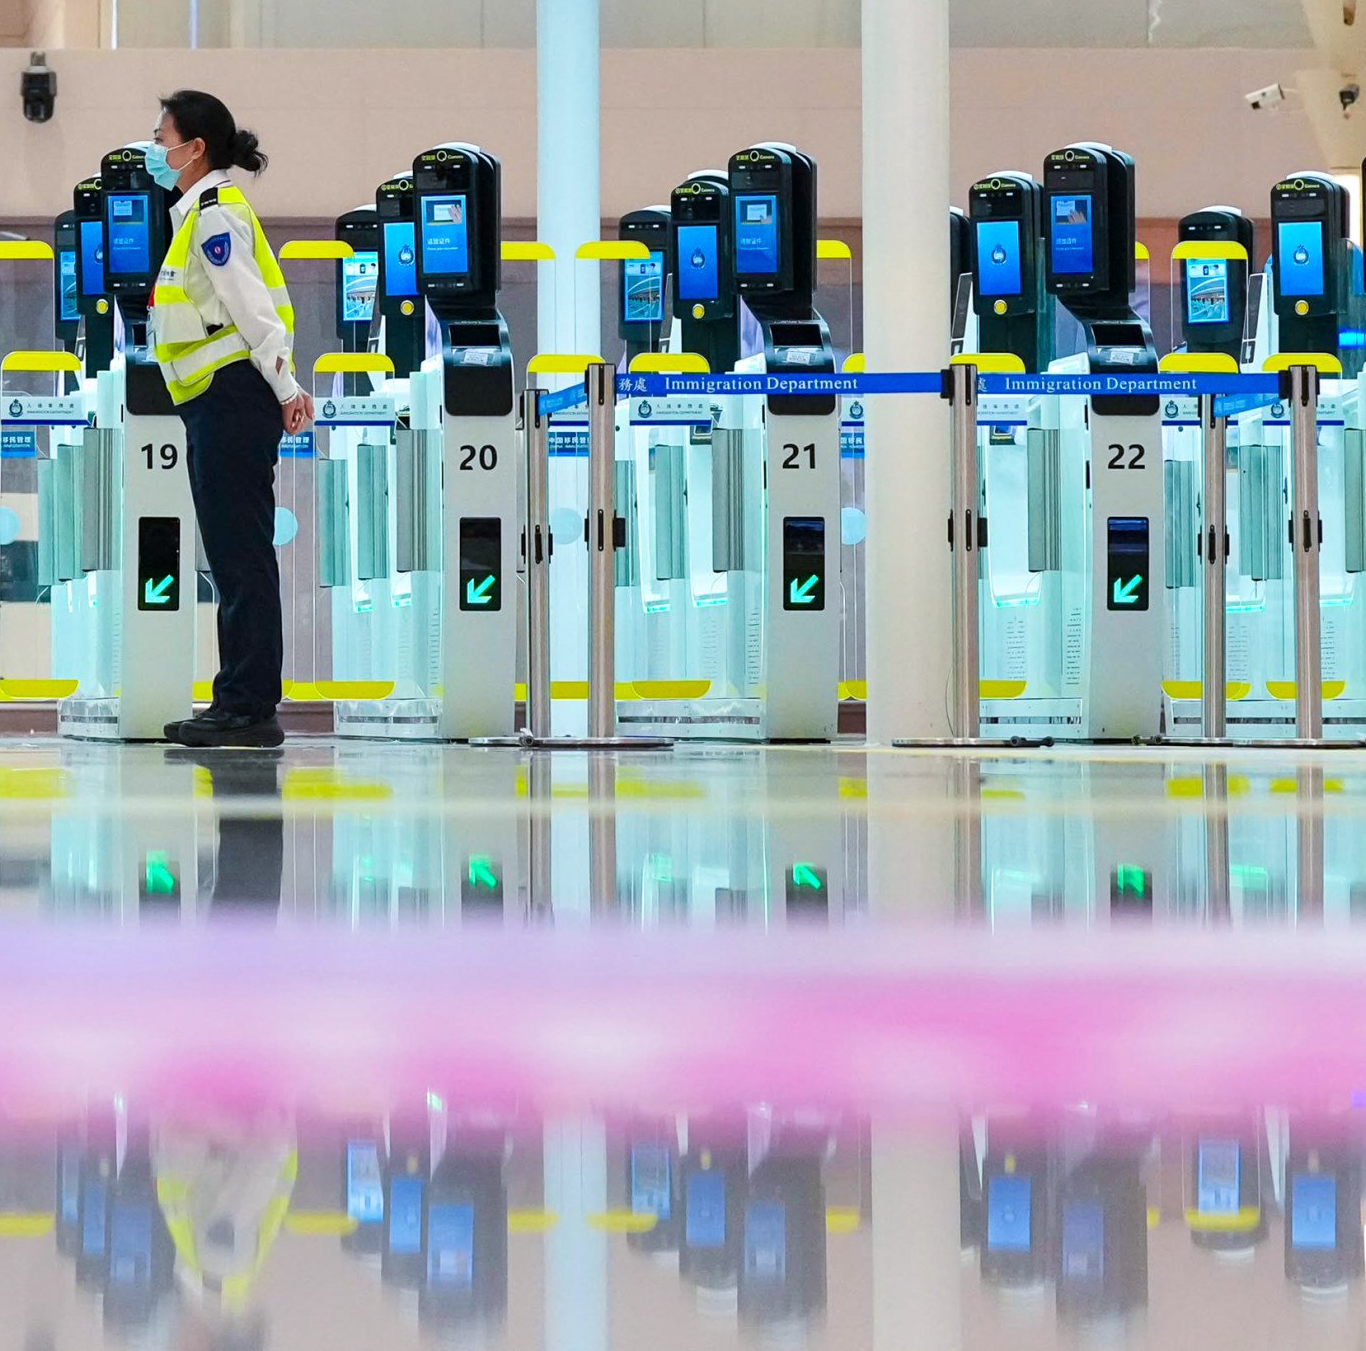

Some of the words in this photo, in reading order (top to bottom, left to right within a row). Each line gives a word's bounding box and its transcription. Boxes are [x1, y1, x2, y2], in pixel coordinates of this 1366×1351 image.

[664, 376, 763, 394] Immigration
[767, 376, 859, 393] Department
[1004, 377, 1102, 394] Immigration
[1106, 377, 1197, 393] Department
[548, 436, 590, 444] 中国移民管
[141, 444, 178, 470] 19
[459, 444, 497, 471] 20
[782, 444, 816, 469] 21
[1107, 444, 1146, 469] 22
